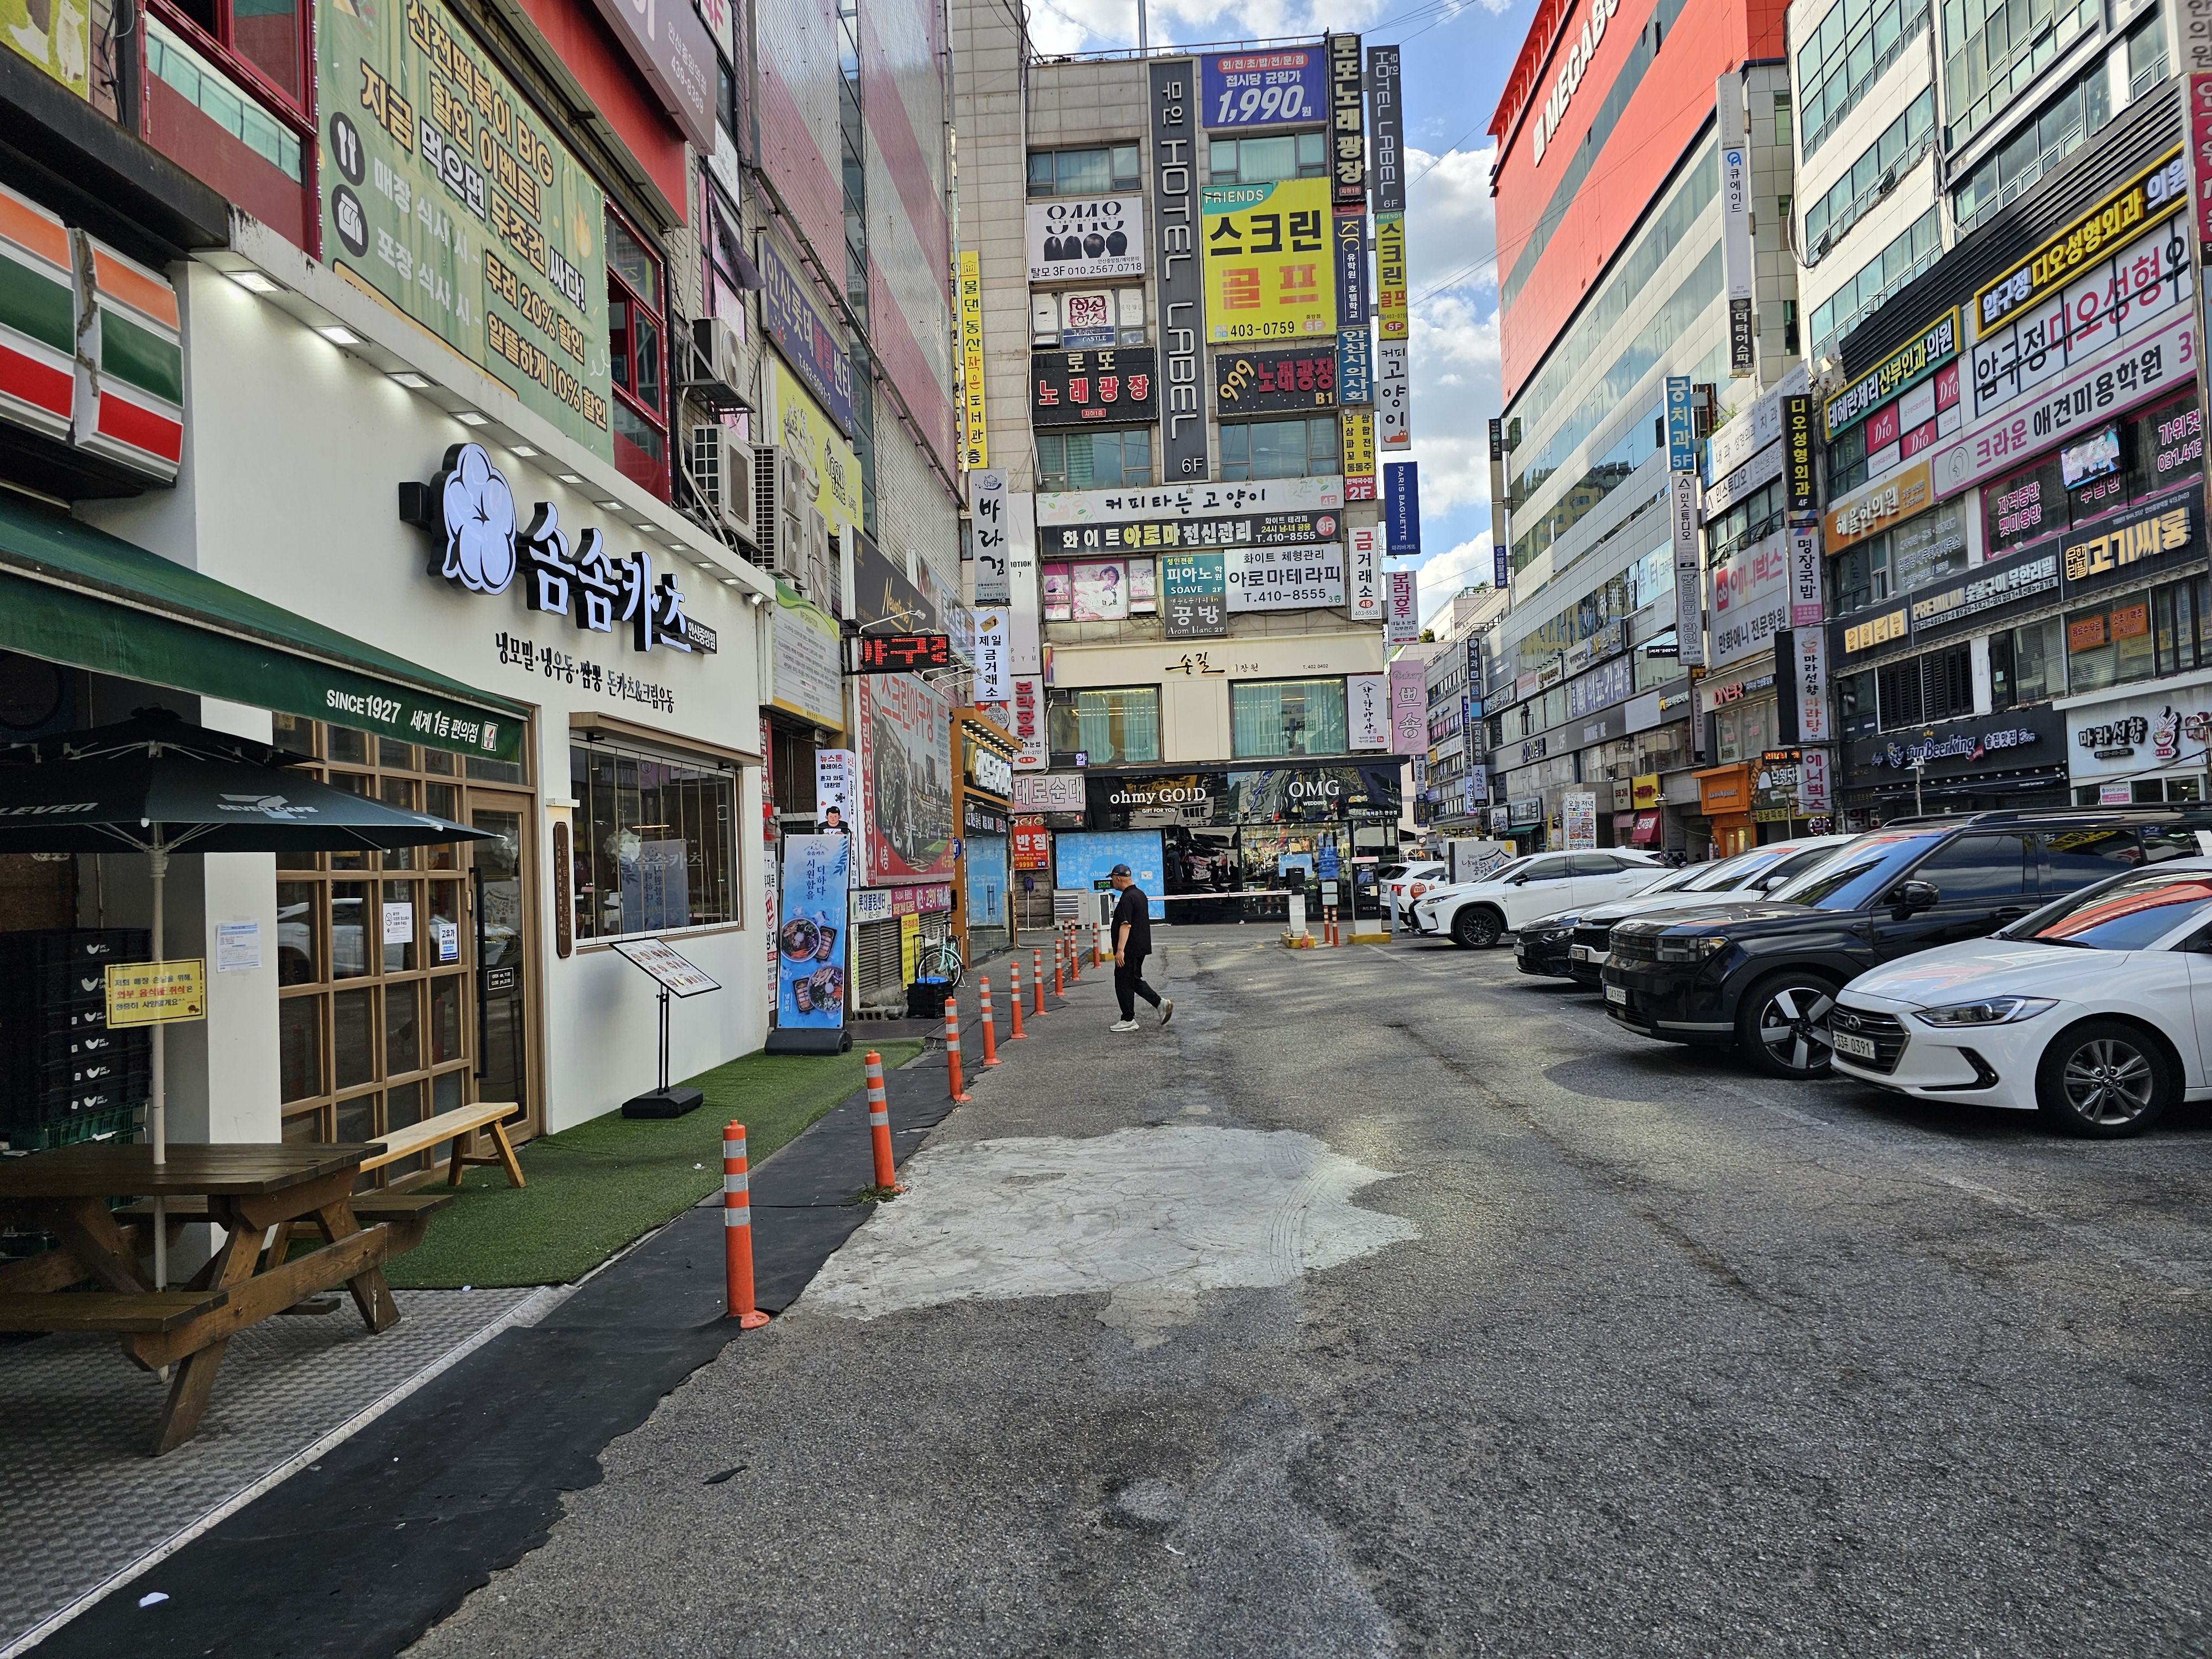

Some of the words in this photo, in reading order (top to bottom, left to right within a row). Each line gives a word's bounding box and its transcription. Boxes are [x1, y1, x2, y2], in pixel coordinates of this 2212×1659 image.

[667, 20, 708, 96] 안산중앙역점
[671, 56, 704, 115] 439-8389
[1226, 75, 1261, 87] 접시당
[1266, 71, 1301, 85] 균일가
[1375, 51, 1391, 117] HOTEL
[1217, 85, 1305, 123] 1,990
[1302, 107, 1312, 117] 원
[430, 71, 474, 158] 할인
[479, 127, 541, 223] 이벤트!
[517, 114, 554, 187] BIG
[1378, 121, 1395, 196] LABEL
[360, 58, 414, 154] 지금
[420, 116, 486, 222] 먹으면
[491, 187, 546, 277] 무조건
[549, 246, 586, 314] 싸다!
[374, 157, 411, 214] 매장
[417, 196, 449, 247] 식사
[1205, 189, 1265, 204] FRIENDS
[1729, 168, 1743, 214] 큐에이드
[1161, 139, 1191, 279] HOTEL
[1384, 200, 1398, 208] 6F
[1209, 210, 1323, 257] 스크린
[377, 226, 413, 280] 포장
[419, 262, 451, 312] 식사
[1031, 267, 1051, 278] 탈모
[1053, 266, 1065, 276] 3F
[1068, 263, 1142, 275] 010.2567.0718
[1221, 263, 1319, 310] 골프
[1381, 290, 1406, 309] 골프
[485, 248, 518, 310] 무려
[520, 283, 556, 341] 20%
[557, 314, 585, 366] 할인
[1230, 321, 1295, 337] 403-0759
[1306, 321, 1322, 331] 5F
[1387, 322, 1401, 331] 5F
[1342, 330, 1369, 402] 안산시의사회
[1381, 349, 1405, 358] 커피
[487, 311, 547, 389] 알뜰하게
[550, 361, 581, 411] 10%
[582, 387, 607, 432] 할인
[1166, 302, 1198, 439] LABEL
[1220, 359, 1255, 402] 999
[1258, 358, 1334, 393] 노래광장
[1039, 374, 1149, 405] 노래광장
[1316, 392, 1333, 405] B1
[1938, 371, 1959, 404] Dio
[1668, 380, 1691, 450] 궁치과
[1976, 419, 2027, 468] 크라운
[2033, 344, 2163, 437] 애견미용학원
[1874, 414, 1892, 444] Dio
[1911, 425, 1929, 454] Dio
[1672, 454, 1693, 467] 5F
[1791, 399, 1811, 496] 디오성형외과
[1182, 458, 1203, 473] 6F
[1348, 463, 1372, 472] 동동주
[1349, 487, 1371, 500] 2F
[1798, 499, 1808, 507] 4F
[1998, 482, 2040, 515] 자격증반
[1320, 521, 1333, 531] 3F
[1399, 494, 1407, 541] BAGUETTE
[1680, 493, 1691, 540] 인스튜디오
[1255, 531, 1316, 544] T.410-8555
[2089, 507, 2192, 575] 고기싸롱
[1244, 553, 1275, 564] 화이트
[1282, 549, 1324, 562] 체형관리
[1355, 531, 1373, 598] 금거래소
[1730, 547, 1783, 596] 애니벅스
[1798, 539, 1817, 599] 명장국밥
[520, 502, 691, 653] 솜솜카츠
[1167, 567, 1213, 583] 피아노
[1171, 586, 1203, 594] SOAVE
[1229, 566, 1340, 588] 아로마테라피
[1244, 588, 1326, 603] T.410-8555
[1328, 594, 1341, 603] 3층
[1393, 573, 1411, 618] 보라공주
[1172, 606, 1219, 625] 공방
[1719, 623, 1749, 654] 만화애니
[1751, 606, 1787, 641] 전문학원
[979, 635, 1001, 646] 제일
[1470, 650, 1478, 668] 치과
[1804, 655, 1819, 696] 마라선향
[881, 675, 933, 743] 스크린야구장
[1016, 681, 1035, 738] 보라공주
[1714, 682, 1744, 706] DINER
[411, 710, 433, 733] 세계
[434, 710, 450, 736] 1등
[451, 718, 479, 742] 편의점
[1805, 698, 1822, 732] 마라탕
[2079, 716, 2148, 748] 마라선향
[1014, 776, 1084, 806] 대로순대
[1110, 790, 1155, 805] ohmy
[1159, 787, 1206, 802] GO!D
[1288, 780, 1340, 797] OMG
[1806, 754, 1826, 811] 애니벅스
[276, 804, 319, 813] CAFE
[1016, 833, 1047, 852] 반점
[1851, 1038, 1871, 1056] 0391
